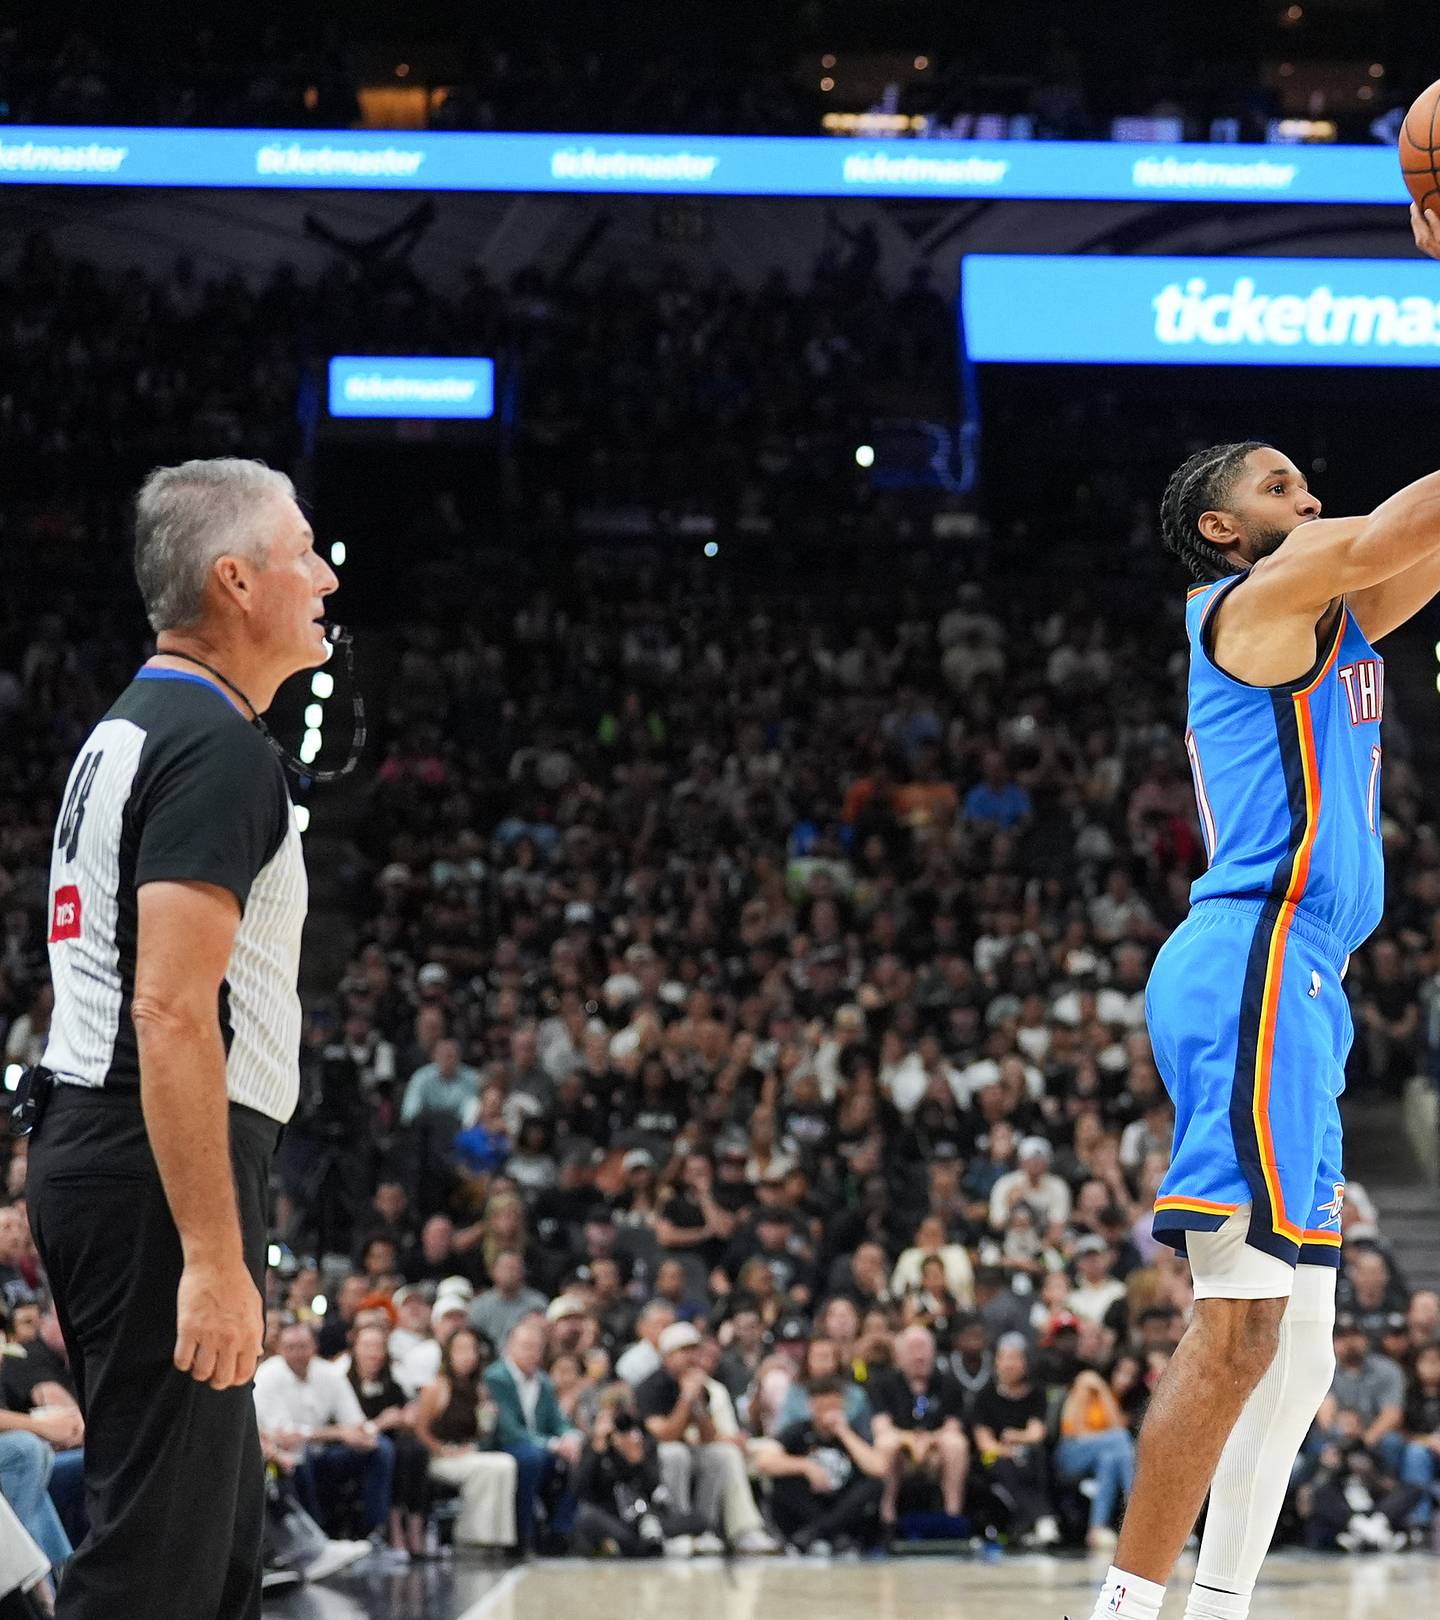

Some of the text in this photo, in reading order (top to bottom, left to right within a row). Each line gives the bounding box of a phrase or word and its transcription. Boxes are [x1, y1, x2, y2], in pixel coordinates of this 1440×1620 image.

[256, 144, 424, 176] ticketmaster
[550, 149, 718, 180] ticketmaster
[842, 154, 1009, 184] ticketmaster
[1132, 158, 1297, 188] ticketmaster
